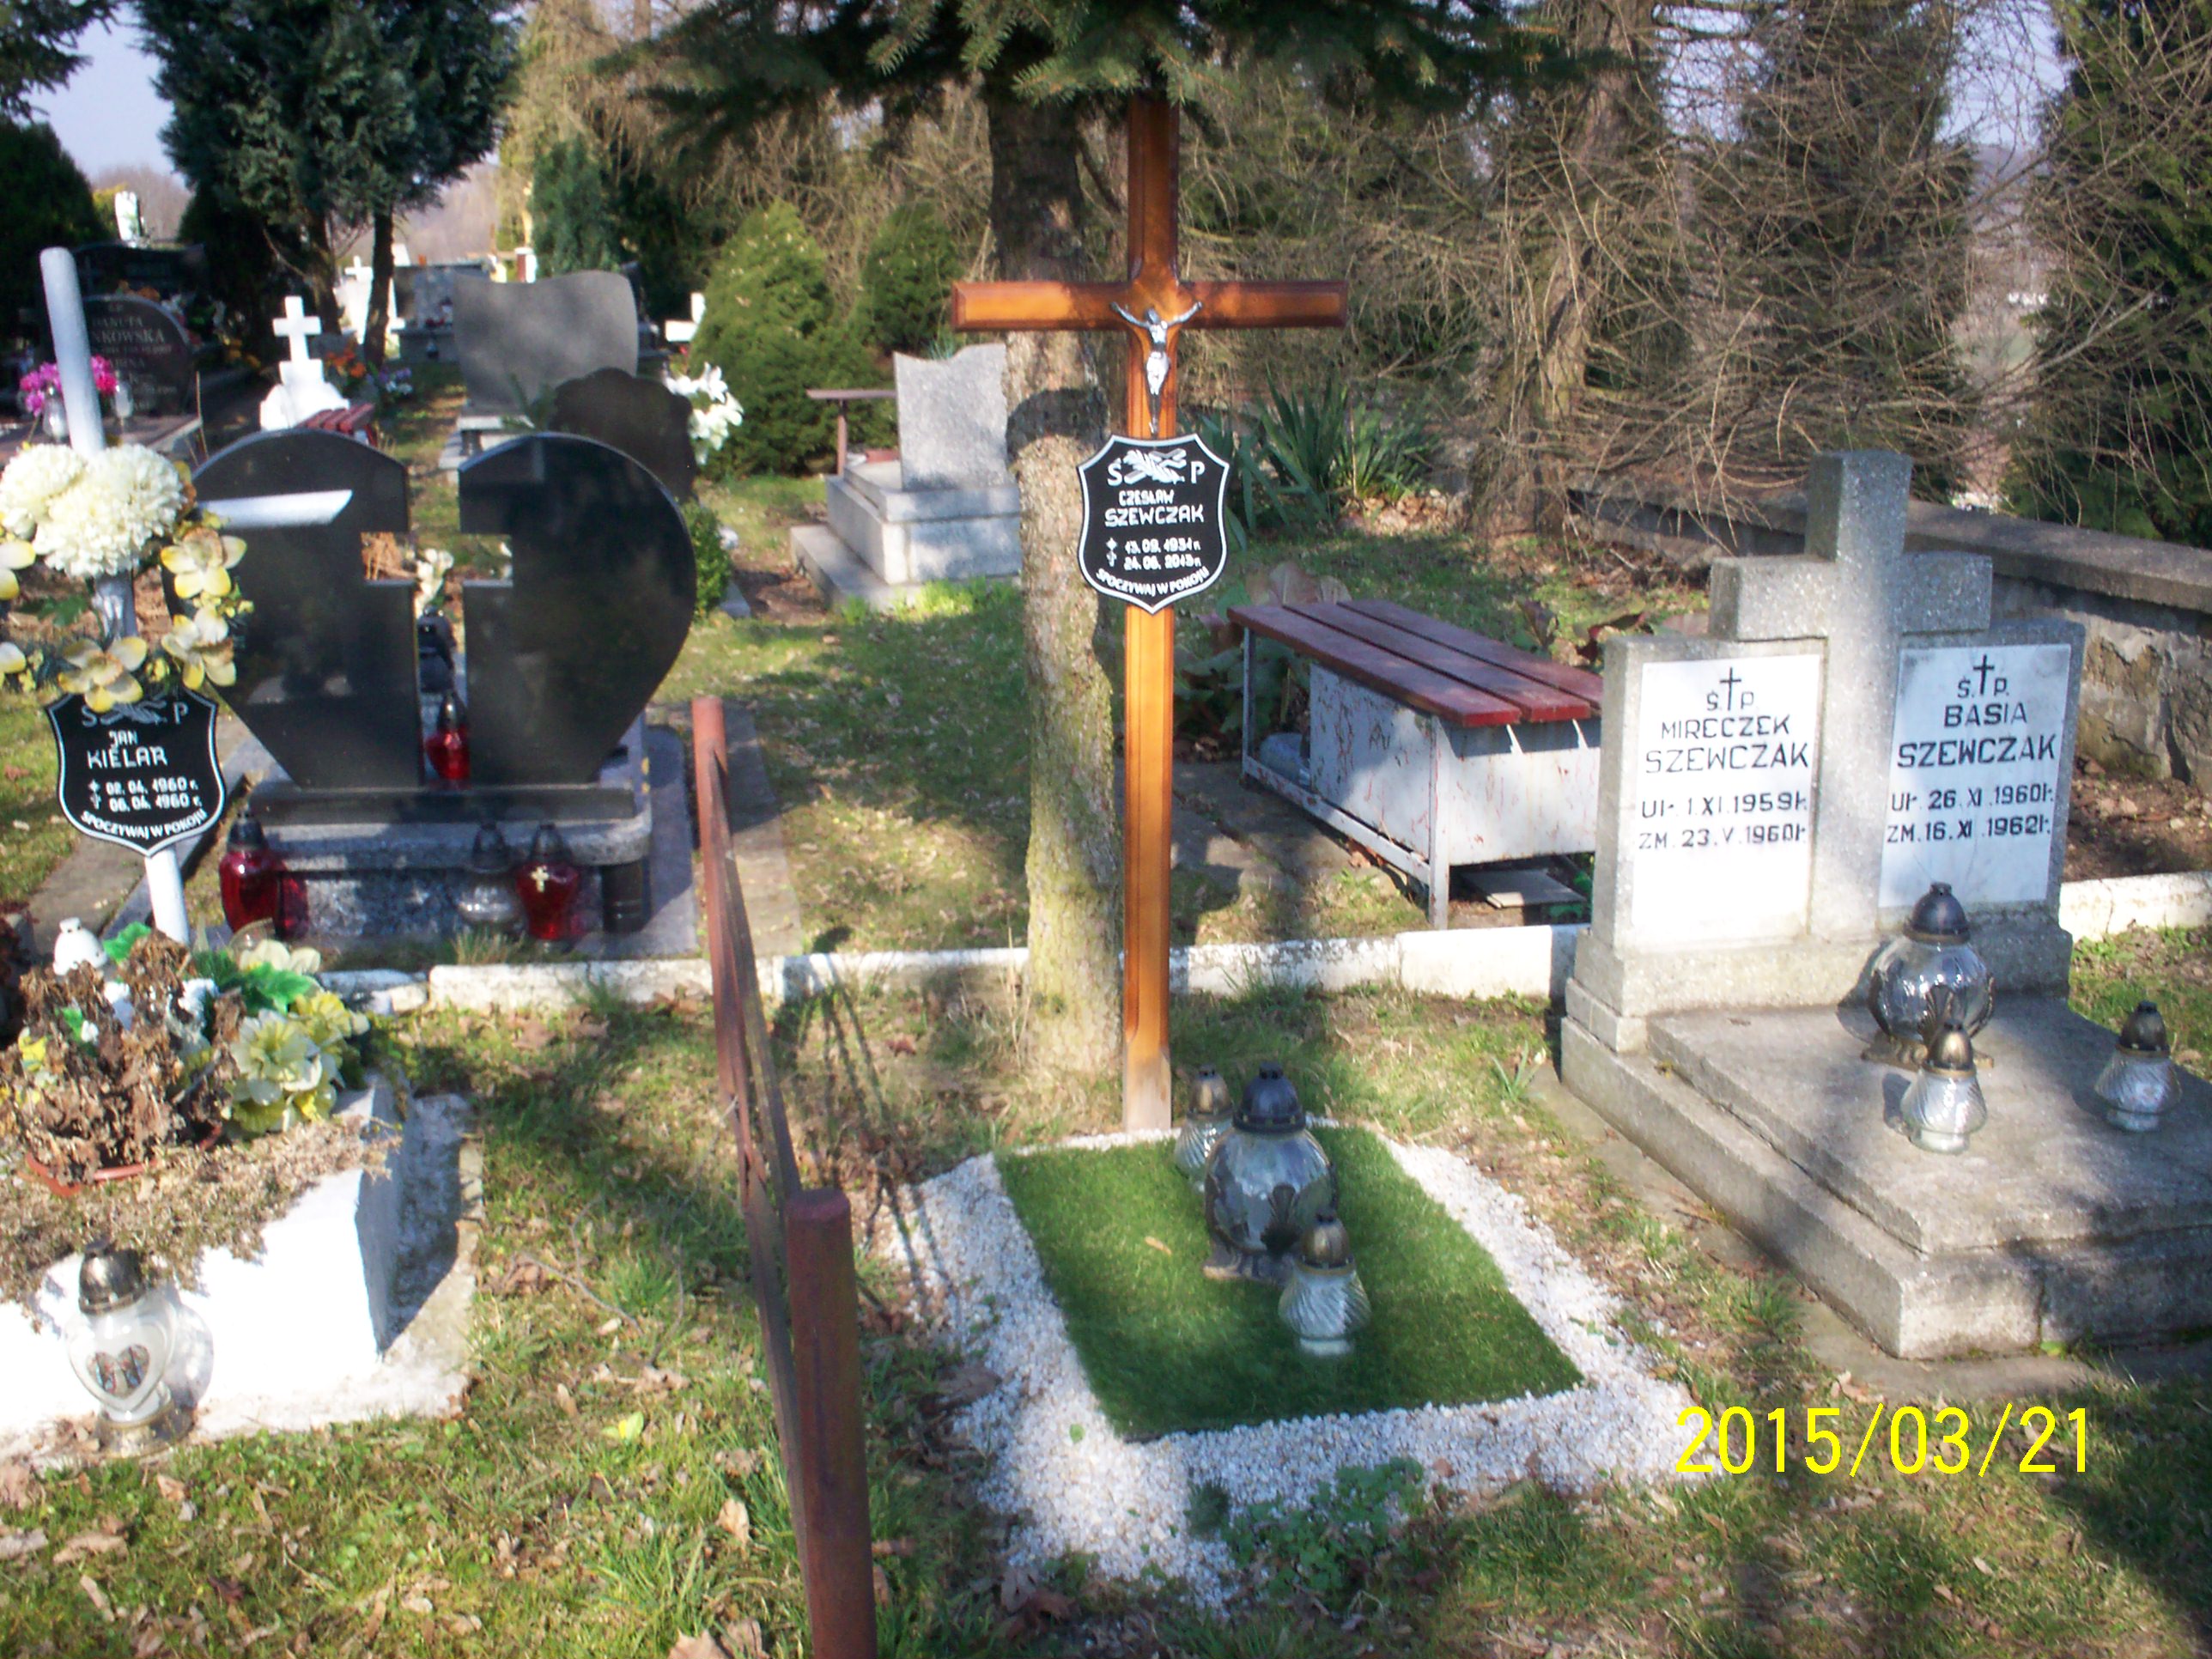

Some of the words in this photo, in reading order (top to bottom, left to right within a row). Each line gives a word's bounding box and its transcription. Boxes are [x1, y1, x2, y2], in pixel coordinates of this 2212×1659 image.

[1190, 461, 1206, 484] P
[1119, 489, 1174, 507] CZESŁAW
[1104, 504, 1205, 527] SZEWCZAK
[1096, 568, 1156, 597] SPOCZYWAJ
[1157, 582, 1170, 593] W
[1170, 566, 1210, 592] POKOJU
[173, 702, 189, 724] P
[1944, 702, 2027, 727] BASIA
[109, 730, 138, 747] JAN
[1661, 714, 1790, 739] MIRECZEK
[87, 745, 168, 769] KIELAR
[1645, 742, 1809, 774] SZEWCZAK
[1897, 733, 2057, 768] SZEWCZAK
[81, 811, 149, 840] SPOCZYWAJ
[149, 825, 163, 837] W
[164, 808, 208, 836] POKOJU
